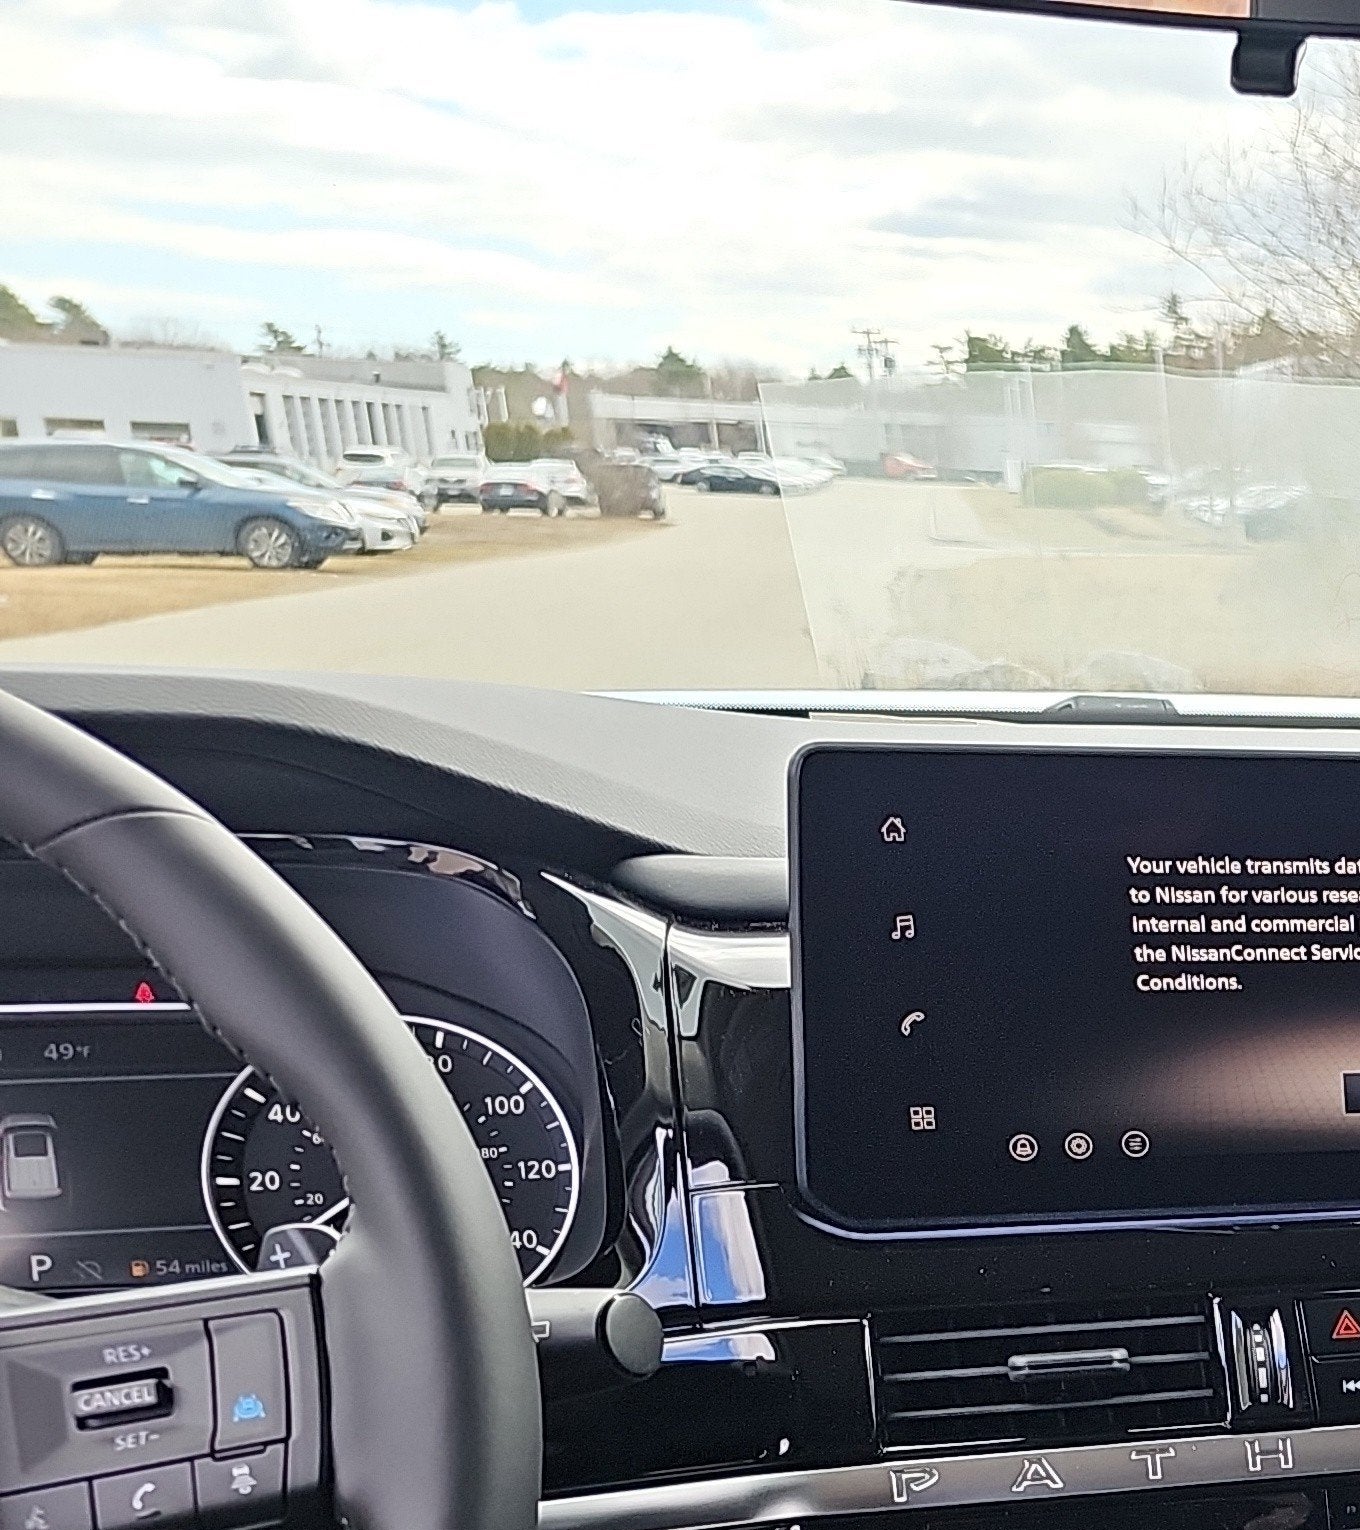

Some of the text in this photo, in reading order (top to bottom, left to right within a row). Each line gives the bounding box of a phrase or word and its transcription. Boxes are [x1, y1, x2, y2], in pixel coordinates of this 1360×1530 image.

[1126, 856, 1173, 874] Your
[1175, 855, 1242, 875] vehicle
[1245, 857, 1331, 875] transmits
[1128, 887, 1151, 904] to
[1155, 886, 1216, 904] Nissan
[1219, 885, 1249, 904] for
[1251, 886, 1319, 904] various
[1132, 914, 1206, 933] internal
[1210, 914, 1247, 933] and
[1250, 913, 1355, 933] commercial
[1133, 943, 1167, 963] the
[1170, 944, 1308, 962] NissanConnect
[1136, 972, 1243, 992] Conditions.
[267, 1104, 301, 1123] 40
[484, 1095, 525, 1115] 100
[481, 1147, 498, 1158] 80
[517, 1160, 556, 1179] 120
[249, 1170, 280, 1191] 20
[306, 1193, 323, 1205] 20
[510, 1229, 538, 1249] 40
[30, 1254, 53, 1281] P
[155, 1259, 229, 1275] 54 miles
[77, 1387, 155, 1411] CANCEL
